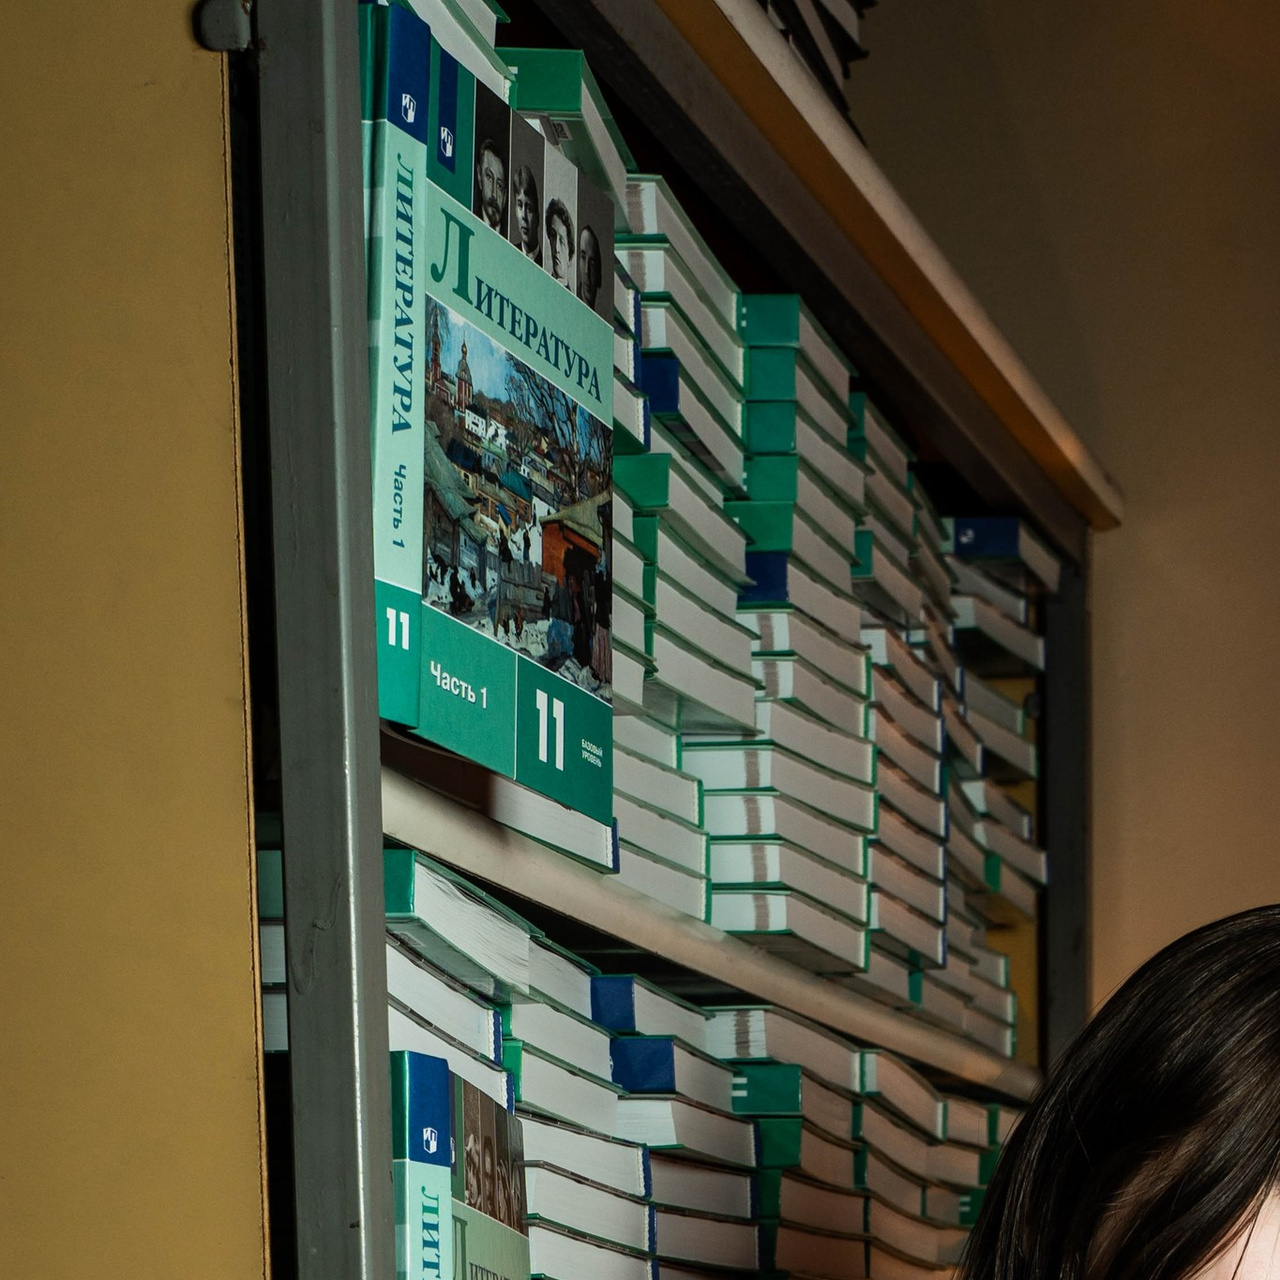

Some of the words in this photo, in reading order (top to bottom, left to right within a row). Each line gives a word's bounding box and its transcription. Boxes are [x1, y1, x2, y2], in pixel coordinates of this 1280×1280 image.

[391, 152, 415, 435] ЛИТЕРАТУРА
[430, 207, 602, 403] ЛИТЕРАТУРА
[392, 463, 407, 530] Часть
[392, 538, 405, 549] 1
[386, 607, 410, 651] 11
[430, 660, 476, 703] Часть
[480, 687, 487, 709] 1
[536, 688, 565, 772] 11
